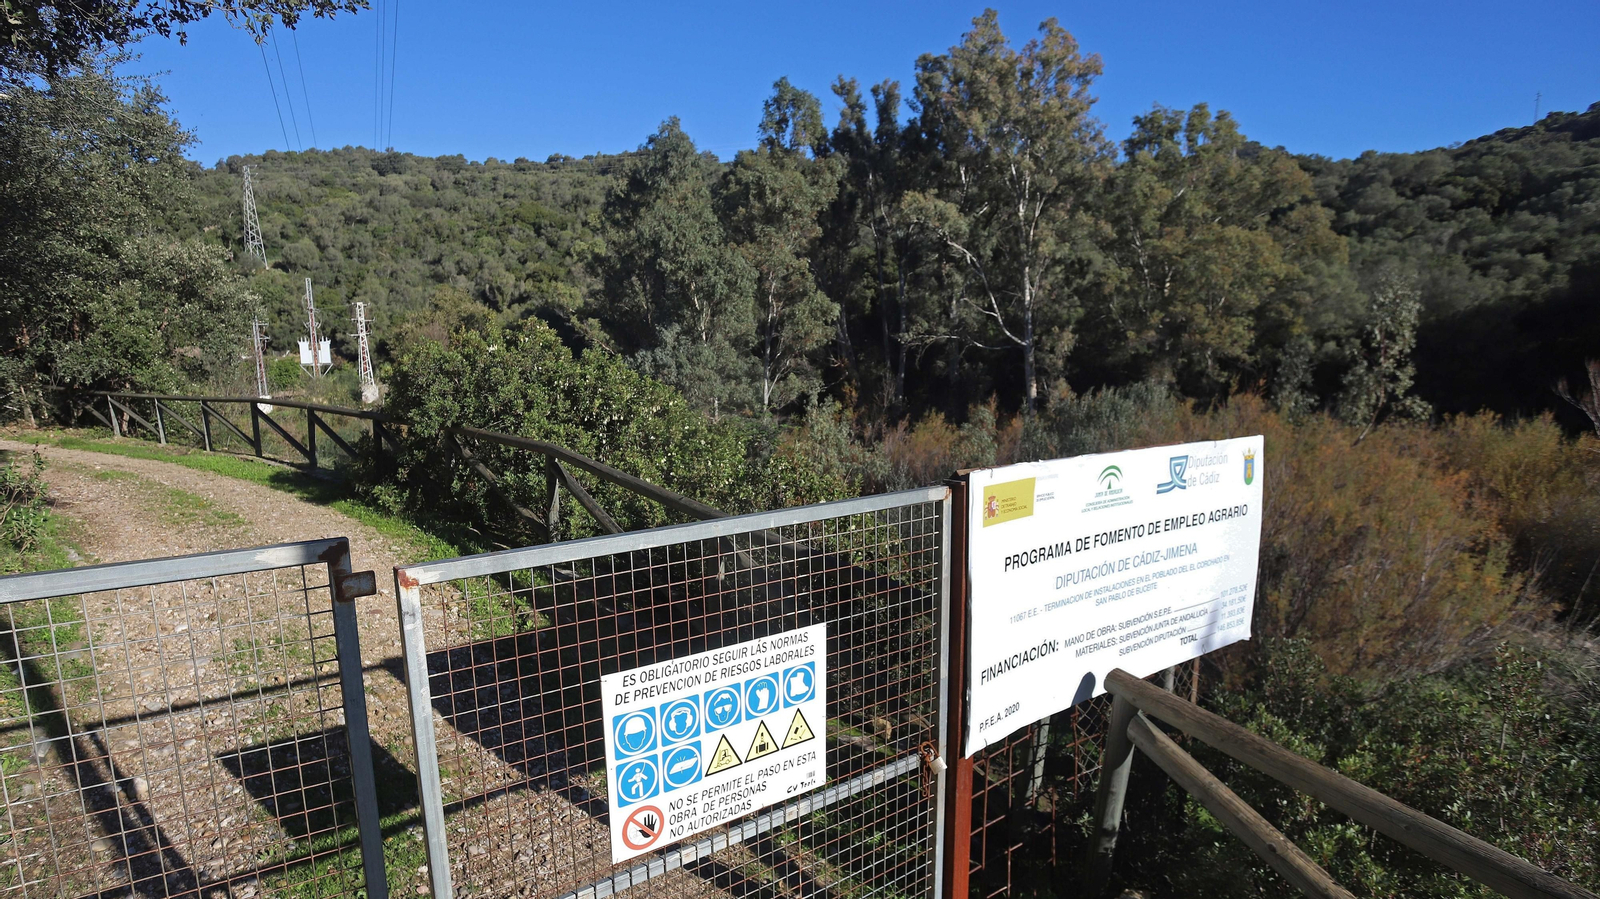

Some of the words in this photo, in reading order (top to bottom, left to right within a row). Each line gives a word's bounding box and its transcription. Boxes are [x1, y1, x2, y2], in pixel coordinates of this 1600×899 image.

[1187, 474, 1197, 487] de
[1199, 472, 1220, 485] Cádiz
[1188, 452, 1228, 469] Diputación
[1005, 541, 1072, 572] PROGRAMA
[1075, 536, 1090, 552] DE
[1094, 524, 1145, 548] FOMENTO
[1148, 521, 1161, 535] DE
[1164, 512, 1206, 532] EMPLEO
[1208, 504, 1248, 523] AGRARIO
[1056, 560, 1115, 590] DIPUTACIÓN
[1118, 558, 1130, 572] DE
[1132, 542, 1198, 568] CÁDIZ-JIMENA
[1010, 612, 1026, 624] 11067
[1028, 608, 1039, 618] E.E.
[1044, 593, 1084, 612] TERMINACION
[1085, 590, 1092, 599] DE
[1094, 578, 1135, 597] INSTALACIONES
[1137, 576, 1144, 584] EN
[1145, 574, 1151, 582] EL
[1152, 568, 1177, 579] POBLADO
[1178, 565, 1188, 574] DEL
[1095, 596, 1107, 606] SAN
[1108, 591, 1126, 602] PABLO
[1127, 588, 1134, 597] DE
[1136, 582, 1158, 595] BUCEITE
[981, 639, 1059, 685] FINANCIACIÓN:
[1065, 634, 1084, 648] MANO
[1086, 630, 1095, 640] DE
[1097, 624, 1117, 637] OBRA:
[1118, 613, 1153, 630] SUBVENCIÓN
[1154, 606, 1172, 618] S.E.P.E.
[1076, 637, 1118, 658] MATERIALES:
[1119, 624, 1153, 643] SUBVENCIÓN
[1153, 620, 1170, 631] JUNTA
[1171, 617, 1178, 625] DE
[1119, 638, 1153, 656] SUBVENCIÓN
[1154, 627, 1186, 643] DIPUTACIÓN
[1180, 634, 1198, 646] TOTAL
[615, 692, 630, 706] DE
[634, 674, 701, 702] PREVENCION
[704, 670, 718, 683] DE
[720, 659, 761, 679] RIESGOS
[764, 645, 815, 668] LABORALES
[623, 673, 636, 687] ES
[640, 656, 709, 683] OBLIGATORIO
[712, 647, 748, 665] SEGUIR
[770, 632, 808, 650] NORMAS
[980, 712, 1003, 733] P.F.E.A.
[1004, 702, 1019, 718] 2020
[669, 798, 683, 812] NO
[686, 793, 698, 806] SE
[702, 777, 742, 800] PERMITE
[745, 773, 754, 785] EL
[758, 764, 780, 780] PASO
[783, 759, 794, 771] EN
[797, 751, 816, 766] ESTA
[669, 807, 697, 825] OBRA
[703, 799, 716, 813] DE
[718, 780, 767, 807] PERSONAS
[670, 825, 684, 839] NO
[687, 799, 752, 832] AUTORIZADAS
